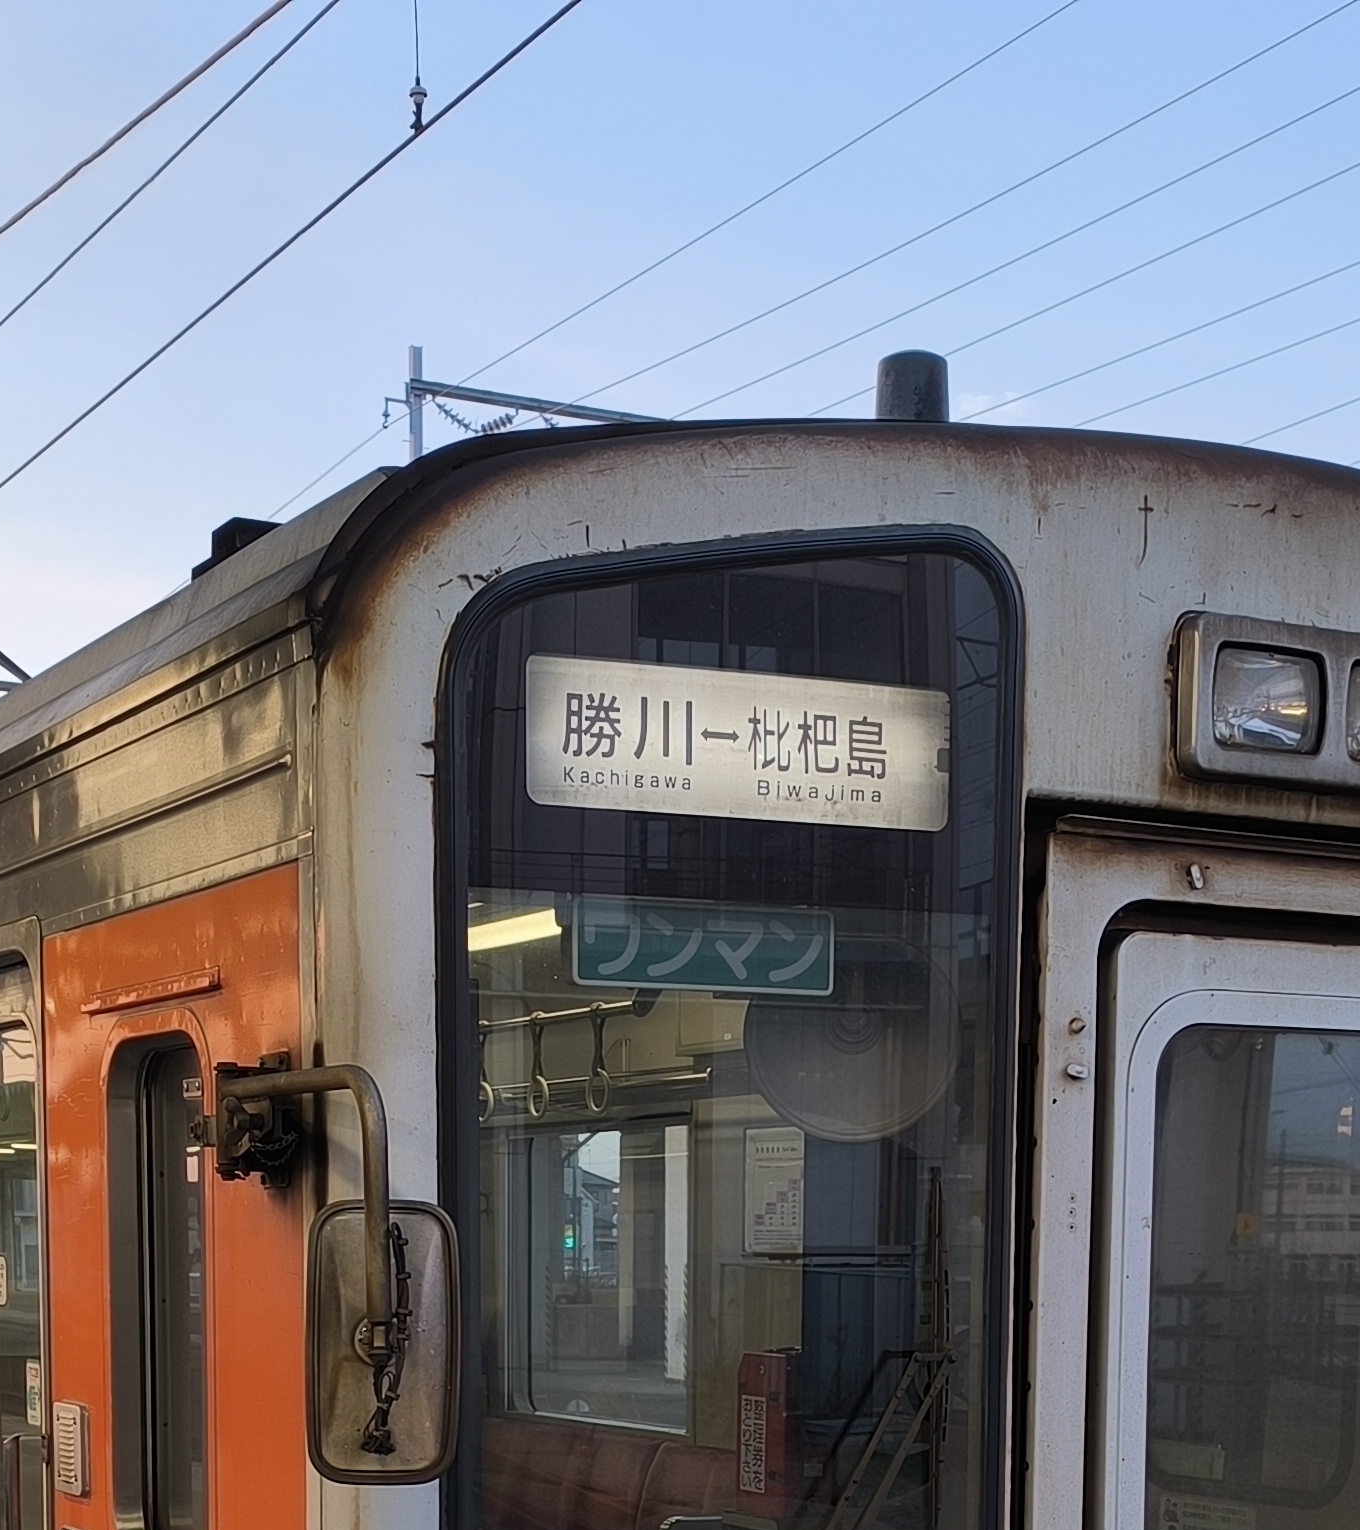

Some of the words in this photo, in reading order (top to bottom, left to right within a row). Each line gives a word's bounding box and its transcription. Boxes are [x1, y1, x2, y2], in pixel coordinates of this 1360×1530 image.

[562, 692, 693, 766] 勝川
[747, 705, 887, 780] 枇杷島
[562, 766, 692, 791] Kachigawa
[756, 779, 883, 803] Biwajima
[583, 911, 824, 983] ワンマン
